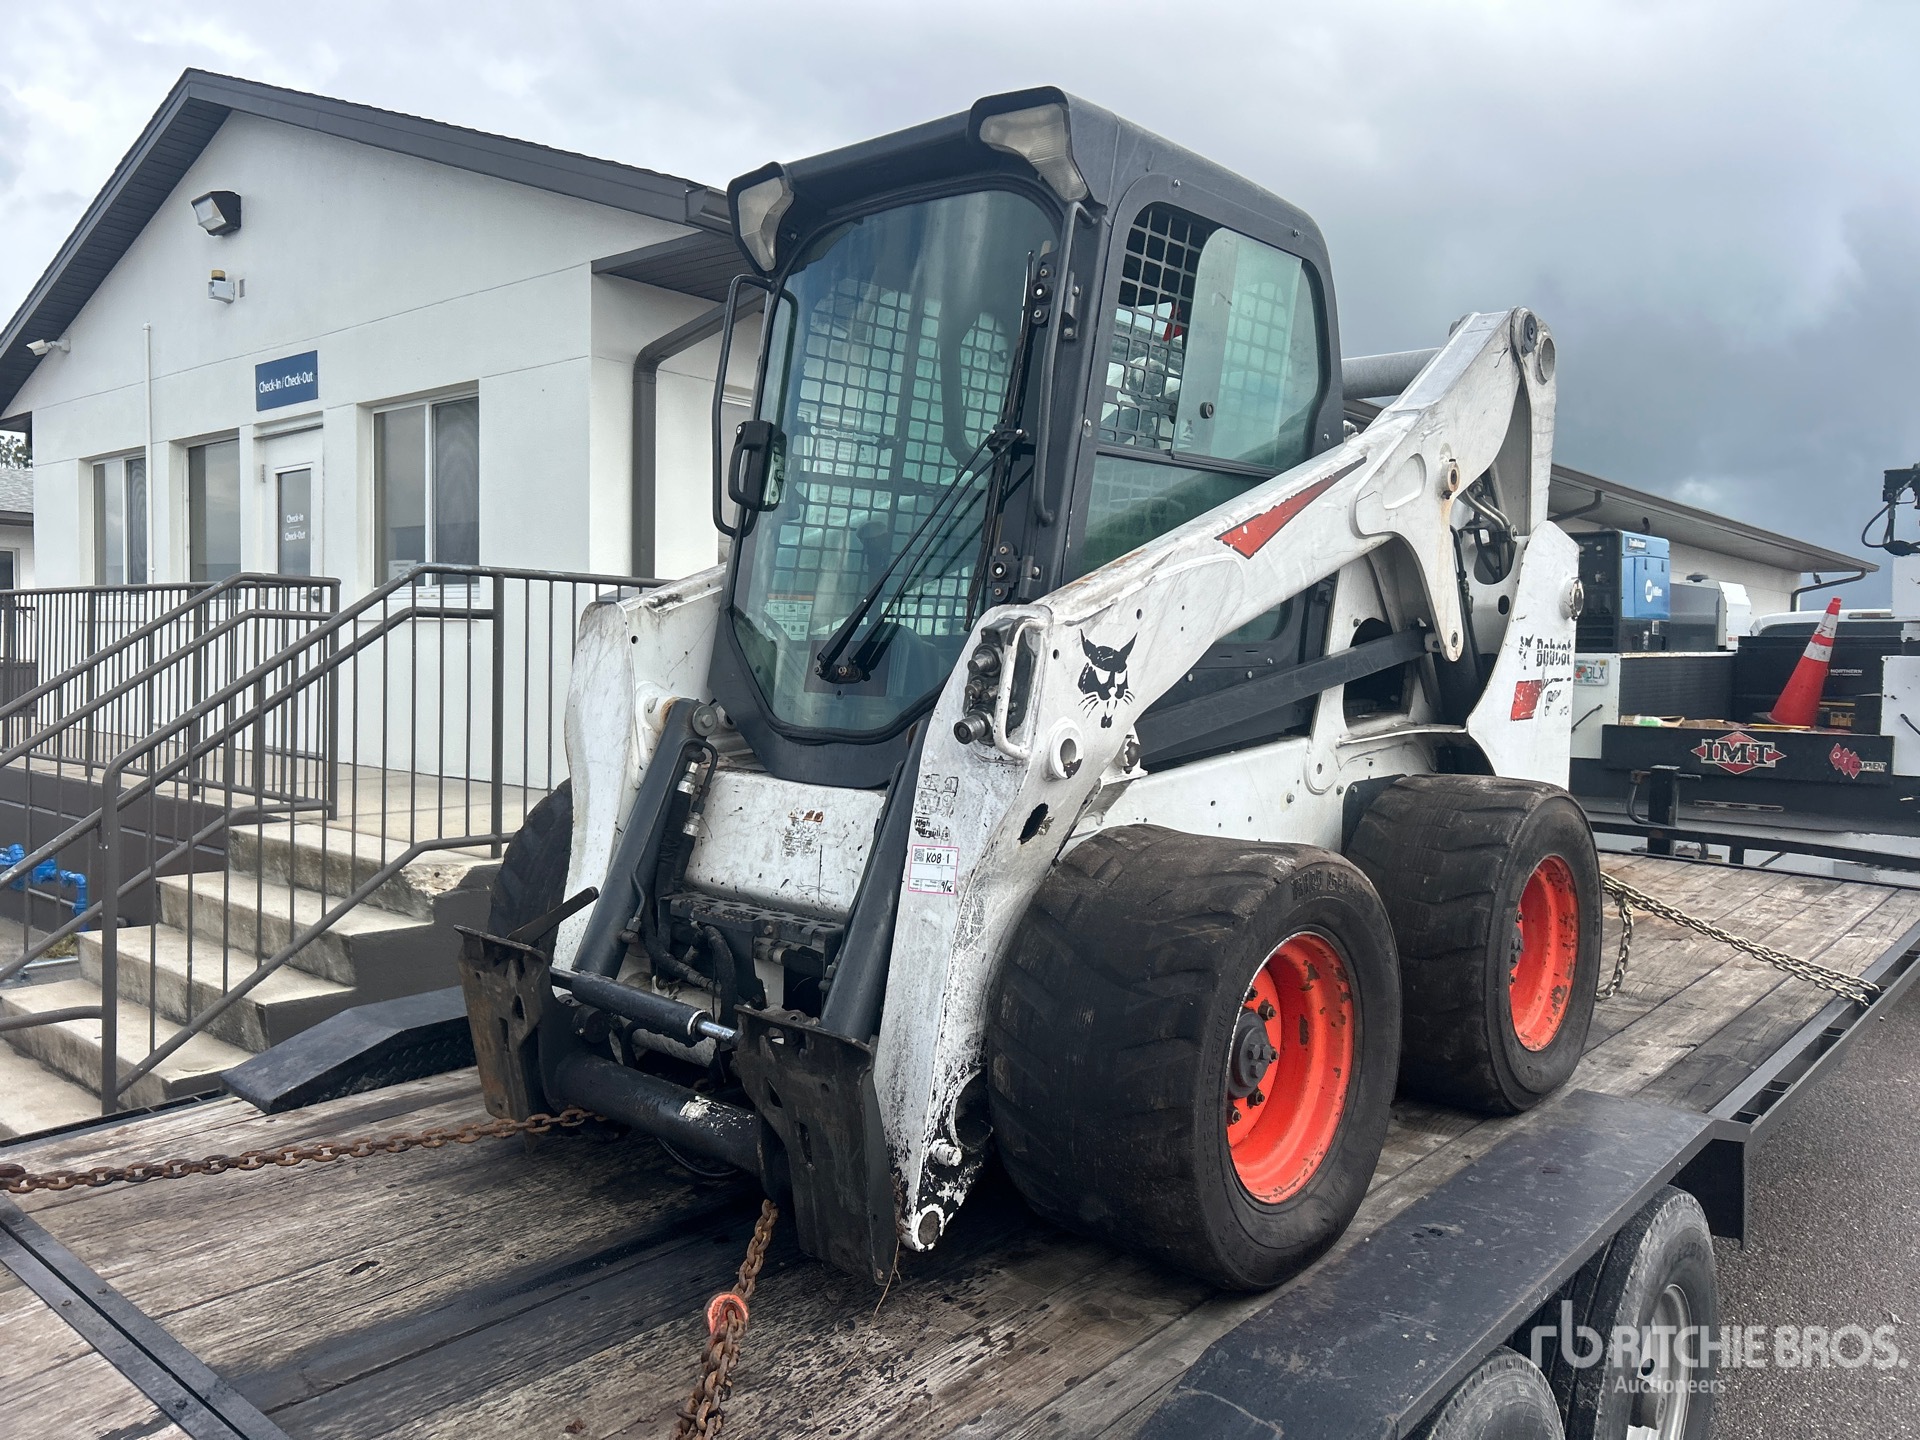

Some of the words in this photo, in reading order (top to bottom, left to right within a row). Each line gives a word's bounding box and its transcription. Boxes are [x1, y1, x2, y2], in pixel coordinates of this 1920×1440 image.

[259, 376, 282, 394] Check-In
[284, 371, 314, 389] Check-Out
[286, 513, 304, 524] Check-In
[284, 531, 306, 542] Check-Out
[1702, 740, 1776, 766] IMT
